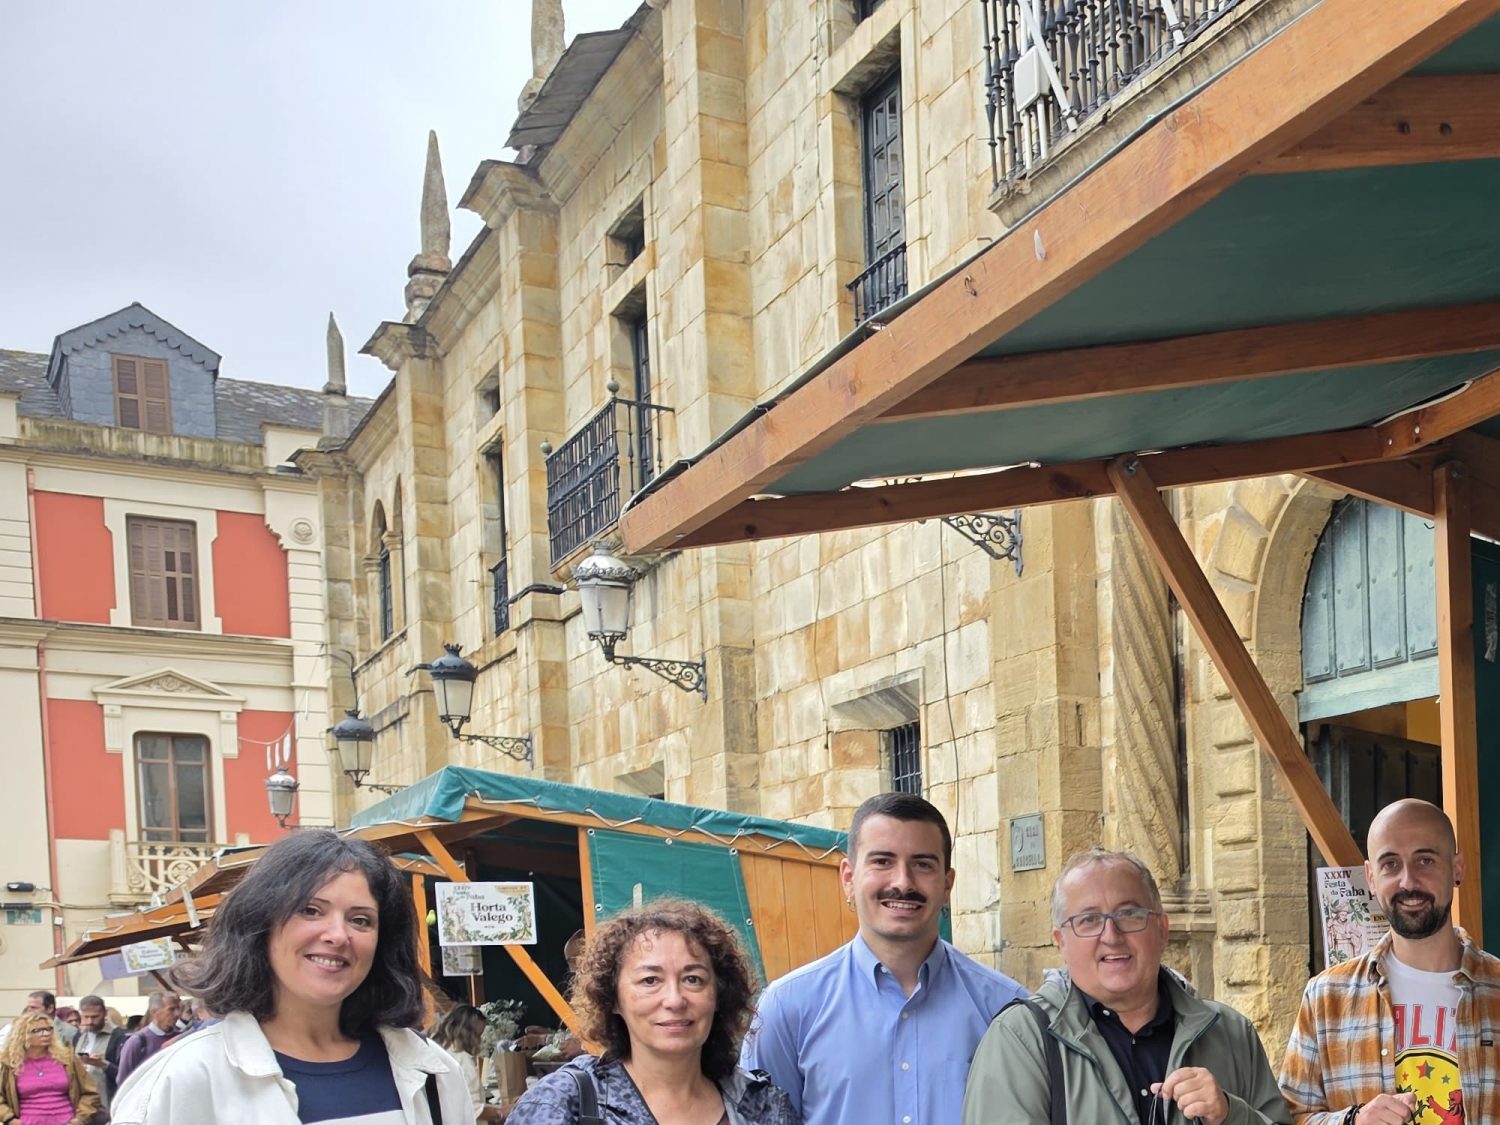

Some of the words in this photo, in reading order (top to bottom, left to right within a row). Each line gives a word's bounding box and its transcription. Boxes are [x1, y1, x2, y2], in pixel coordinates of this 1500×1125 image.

[1324, 869, 1352, 880] XXXIV
[1324, 880, 1346, 889] Festa
[1339, 885, 1365, 898] Faba
[470, 902, 507, 912] Horta
[472, 912, 514, 924] Valego
